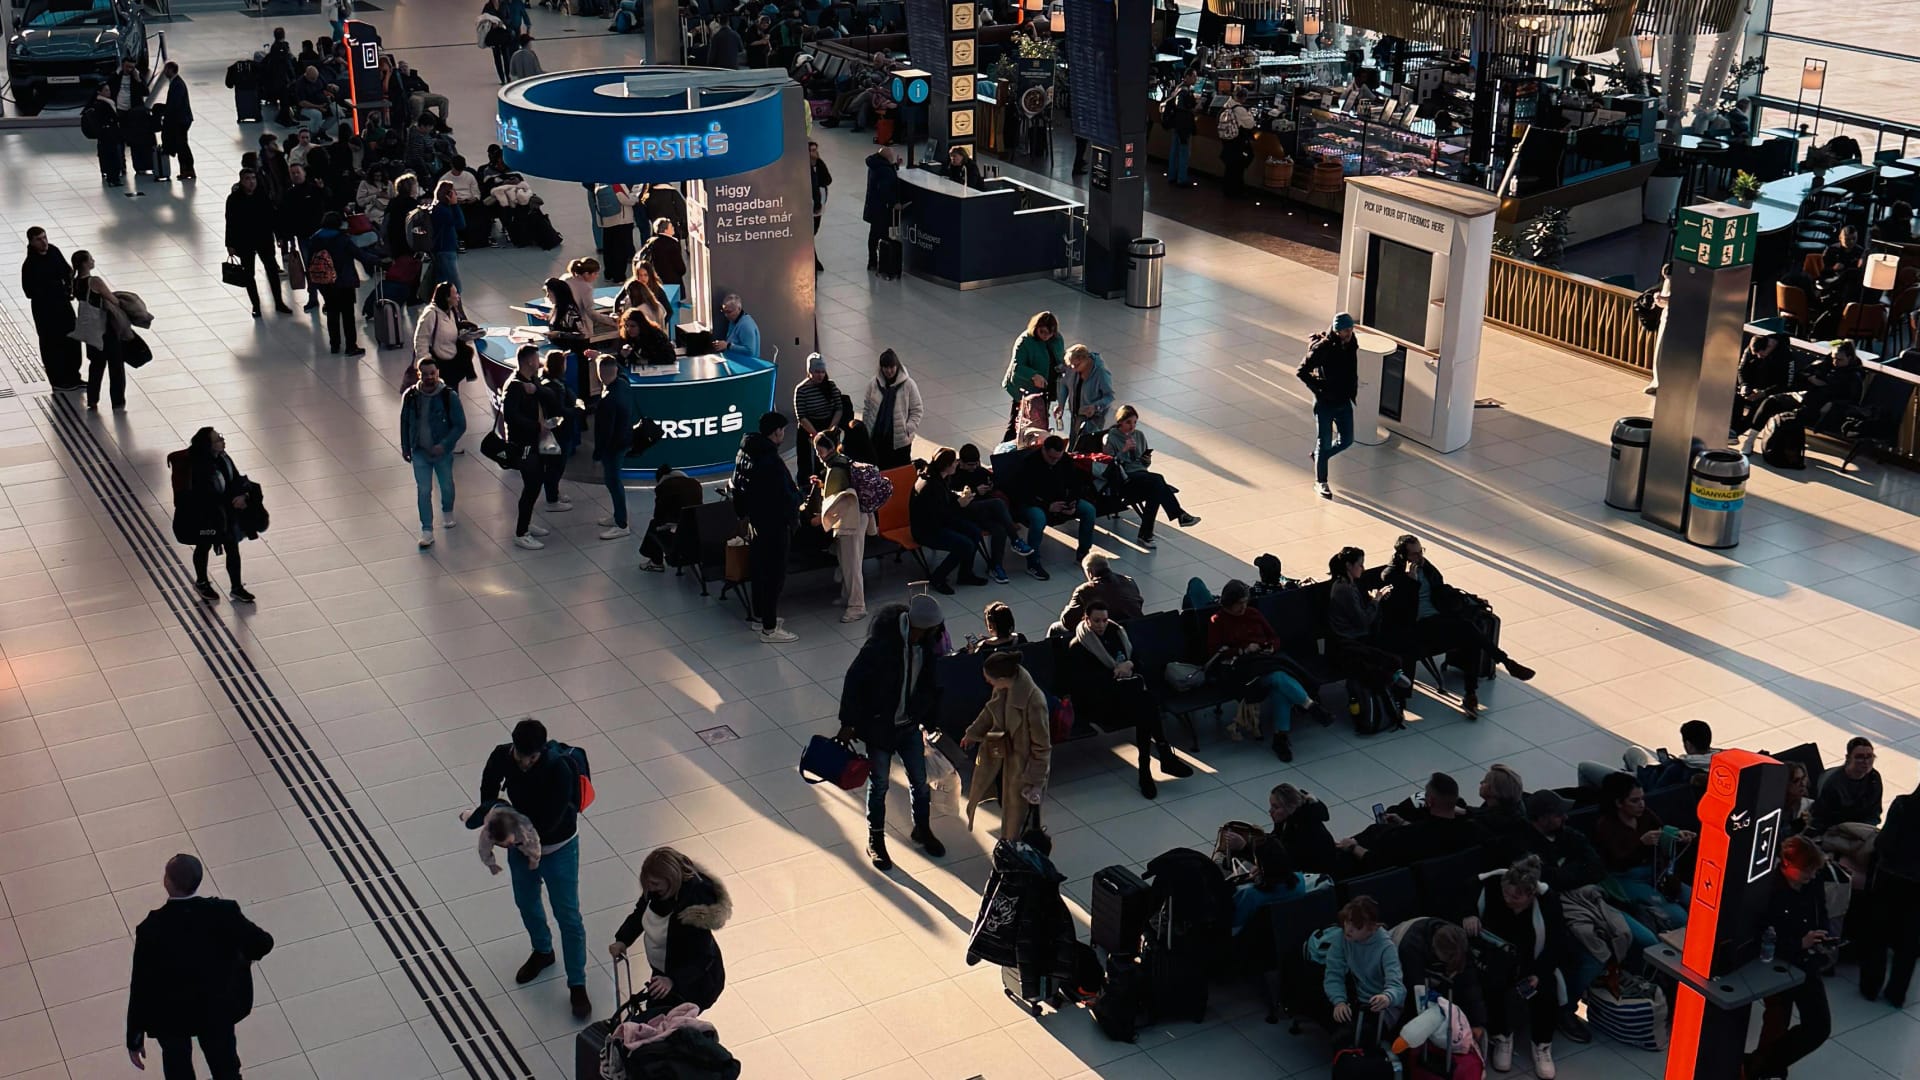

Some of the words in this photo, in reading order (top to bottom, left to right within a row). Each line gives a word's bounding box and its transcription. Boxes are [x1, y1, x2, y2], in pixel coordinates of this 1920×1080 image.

[627, 136, 703, 162] ERSTE
[715, 185, 751, 199] Higgy
[716, 197, 783, 213] magadban!
[716, 216, 733, 228] Az
[735, 215, 767, 227] Erste
[769, 211, 793, 223] már
[1364, 201, 1376, 211] PICK
[1376, 205, 1383, 214] UP
[1384, 207, 1396, 218] YOUR
[1396, 210, 1407, 221] GIFT
[1407, 213, 1430, 228] THERMOS
[1431, 221, 1445, 233] HERE
[717, 231, 742, 243] hisz
[745, 226, 793, 241] benned.
[653, 416, 719, 439] RSTE
